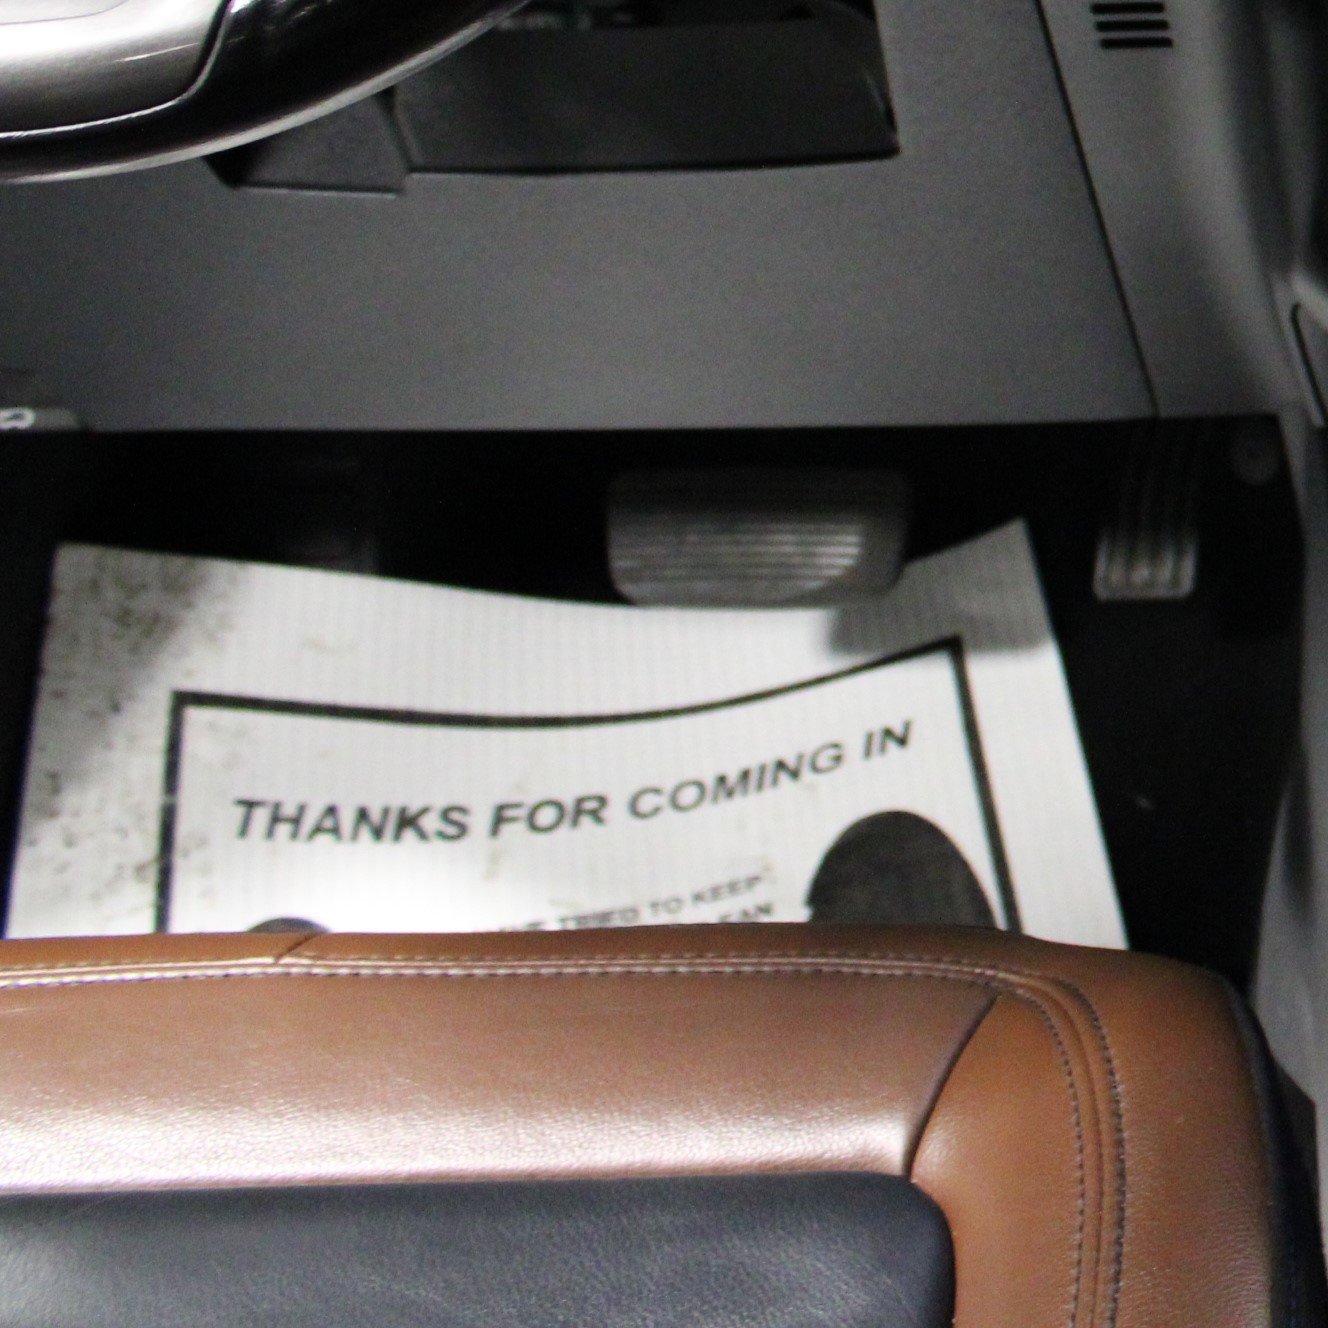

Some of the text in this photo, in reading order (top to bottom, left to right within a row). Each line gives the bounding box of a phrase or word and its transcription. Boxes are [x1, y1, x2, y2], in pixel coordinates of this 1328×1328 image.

[233, 719, 914, 844] THANKS FOR COMING IN
[650, 897, 683, 916] TO
[691, 875, 762, 904] KEEP
